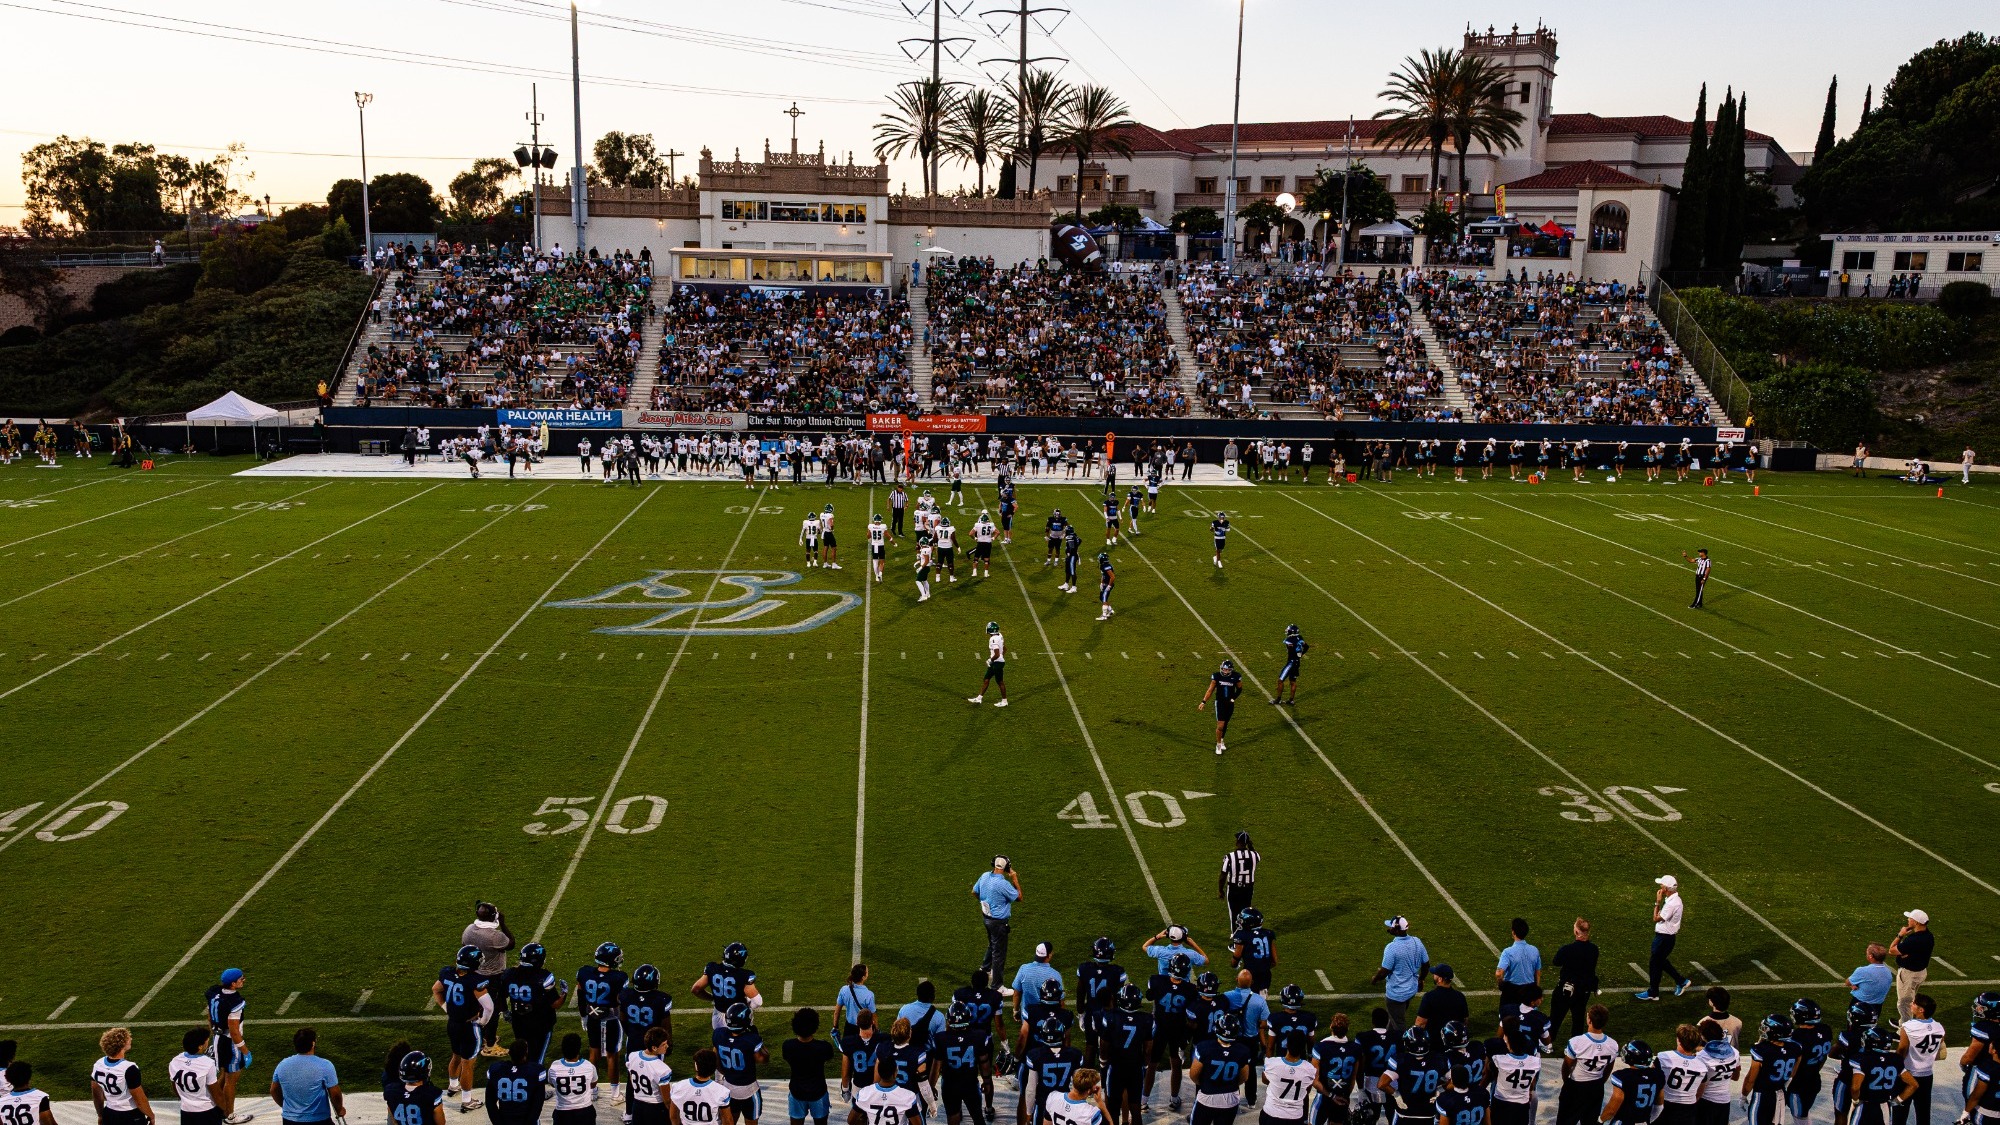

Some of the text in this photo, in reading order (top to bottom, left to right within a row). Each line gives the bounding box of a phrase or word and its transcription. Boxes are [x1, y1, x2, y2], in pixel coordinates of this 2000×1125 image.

[1933, 234, 1953, 242] SAN
[1957, 234, 1989, 242] DIEGO
[508, 411, 563, 421] PALOMAR
[638, 412, 673, 427] Jersey
[705, 413, 733, 426] Subs
[748, 415, 764, 425] The
[783, 416, 807, 427] Diego
[807, 416, 866, 427] Union-Tribune
[1717, 430, 1745, 438] ESPN
[808, 525, 817, 535] 19
[981, 526, 992, 536] 65
[522, 795, 669, 835] 50
[1056, 790, 1188, 828] 40
[1538, 785, 1683, 823] 30
[1238, 859, 1250, 875] L
[1252, 936, 1270, 959] 31
[443, 978, 465, 1006] 76
[585, 979, 610, 1005] 92
[712, 973, 737, 999] 96
[1159, 992, 1187, 1013] 49
[627, 1004, 653, 1027] 93
[1122, 1025, 1137, 1049] 7
[1915, 1034, 1943, 1054] 45
[718, 1045, 745, 1071] 50
[946, 1045, 976, 1070] 54
[1327, 1056, 1356, 1080] 26
[1584, 1055, 1611, 1072] 47
[173, 1070, 201, 1093] 40
[1042, 1062, 1072, 1088] 57
[1210, 1060, 1239, 1081] 70
[1409, 1069, 1439, 1094] 78
[1506, 1069, 1536, 1089] 45
[1667, 1067, 1700, 1092] 67
[1709, 1060, 1737, 1082] 25
[1769, 1058, 1796, 1082] 38
[1868, 1065, 1898, 1091] 29
[95, 1070, 123, 1095] 58
[497, 1077, 529, 1103] 86
[556, 1075, 587, 1096] 83
[629, 1070, 653, 1095] 39
[1279, 1077, 1302, 1101] 71
[1635, 1083, 1657, 1109] 51
[0, 1103, 35, 1125] 36
[393, 1103, 423, 1125] 48
[683, 1100, 713, 1123] 90
[869, 1105, 900, 1125] 79
